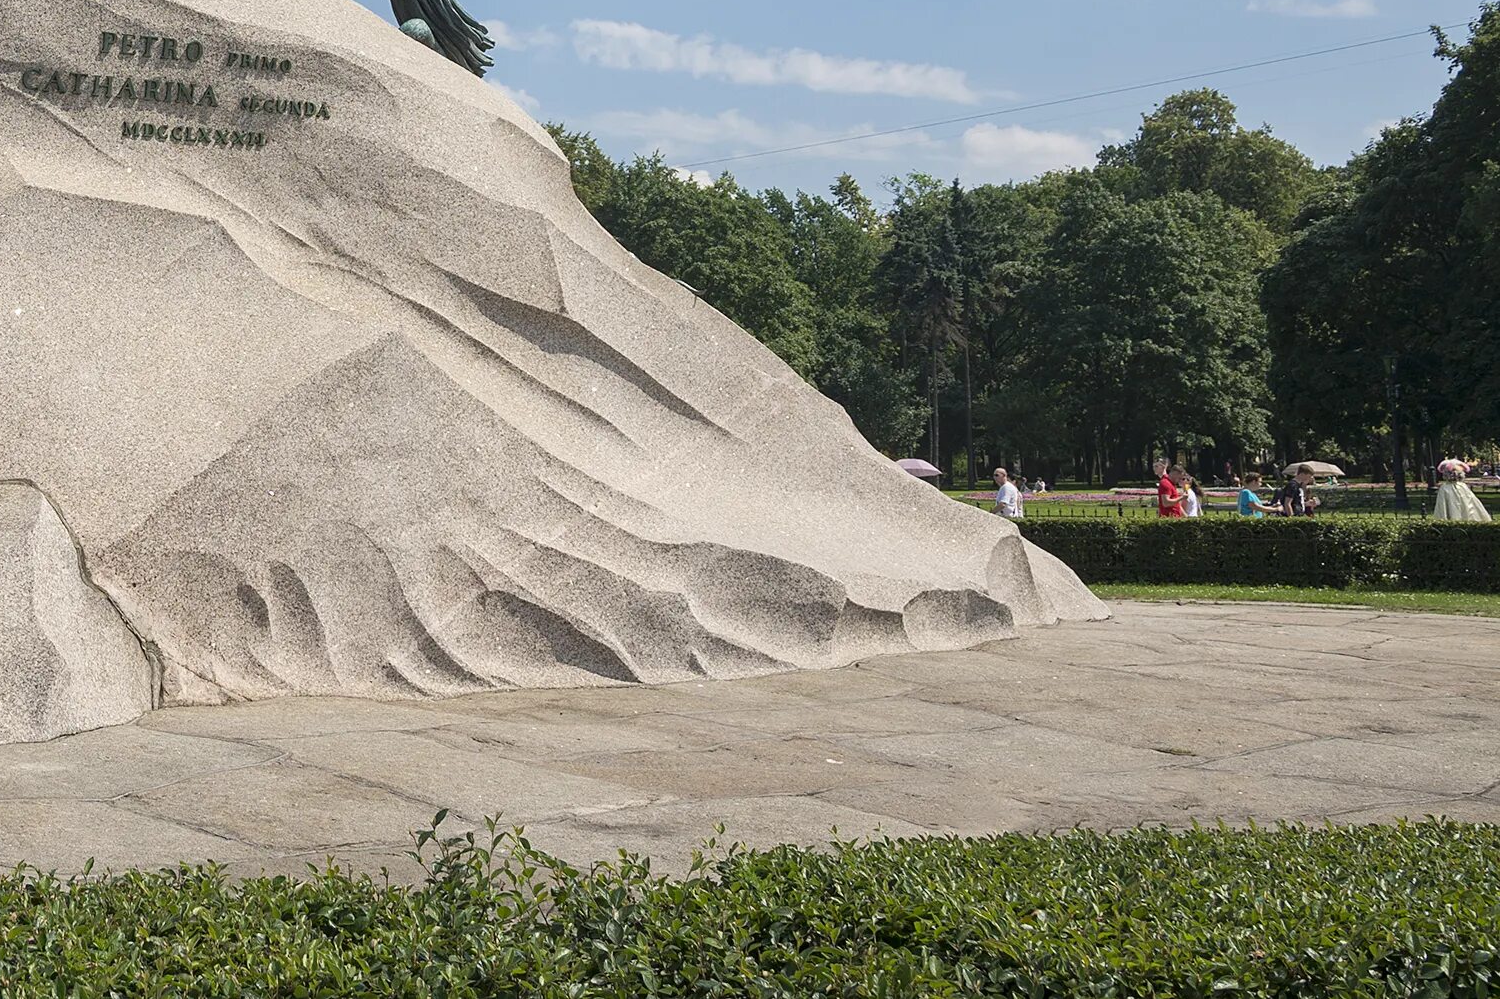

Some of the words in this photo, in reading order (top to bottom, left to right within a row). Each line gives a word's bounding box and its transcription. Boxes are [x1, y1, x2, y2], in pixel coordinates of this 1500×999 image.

[100, 31, 205, 63] PETRO
[227, 52, 292, 73] PRIMO
[21, 69, 219, 107] CATHARINA
[240, 97, 330, 120] SECUNDA
[122, 121, 267, 147] MDCCLXXXII
